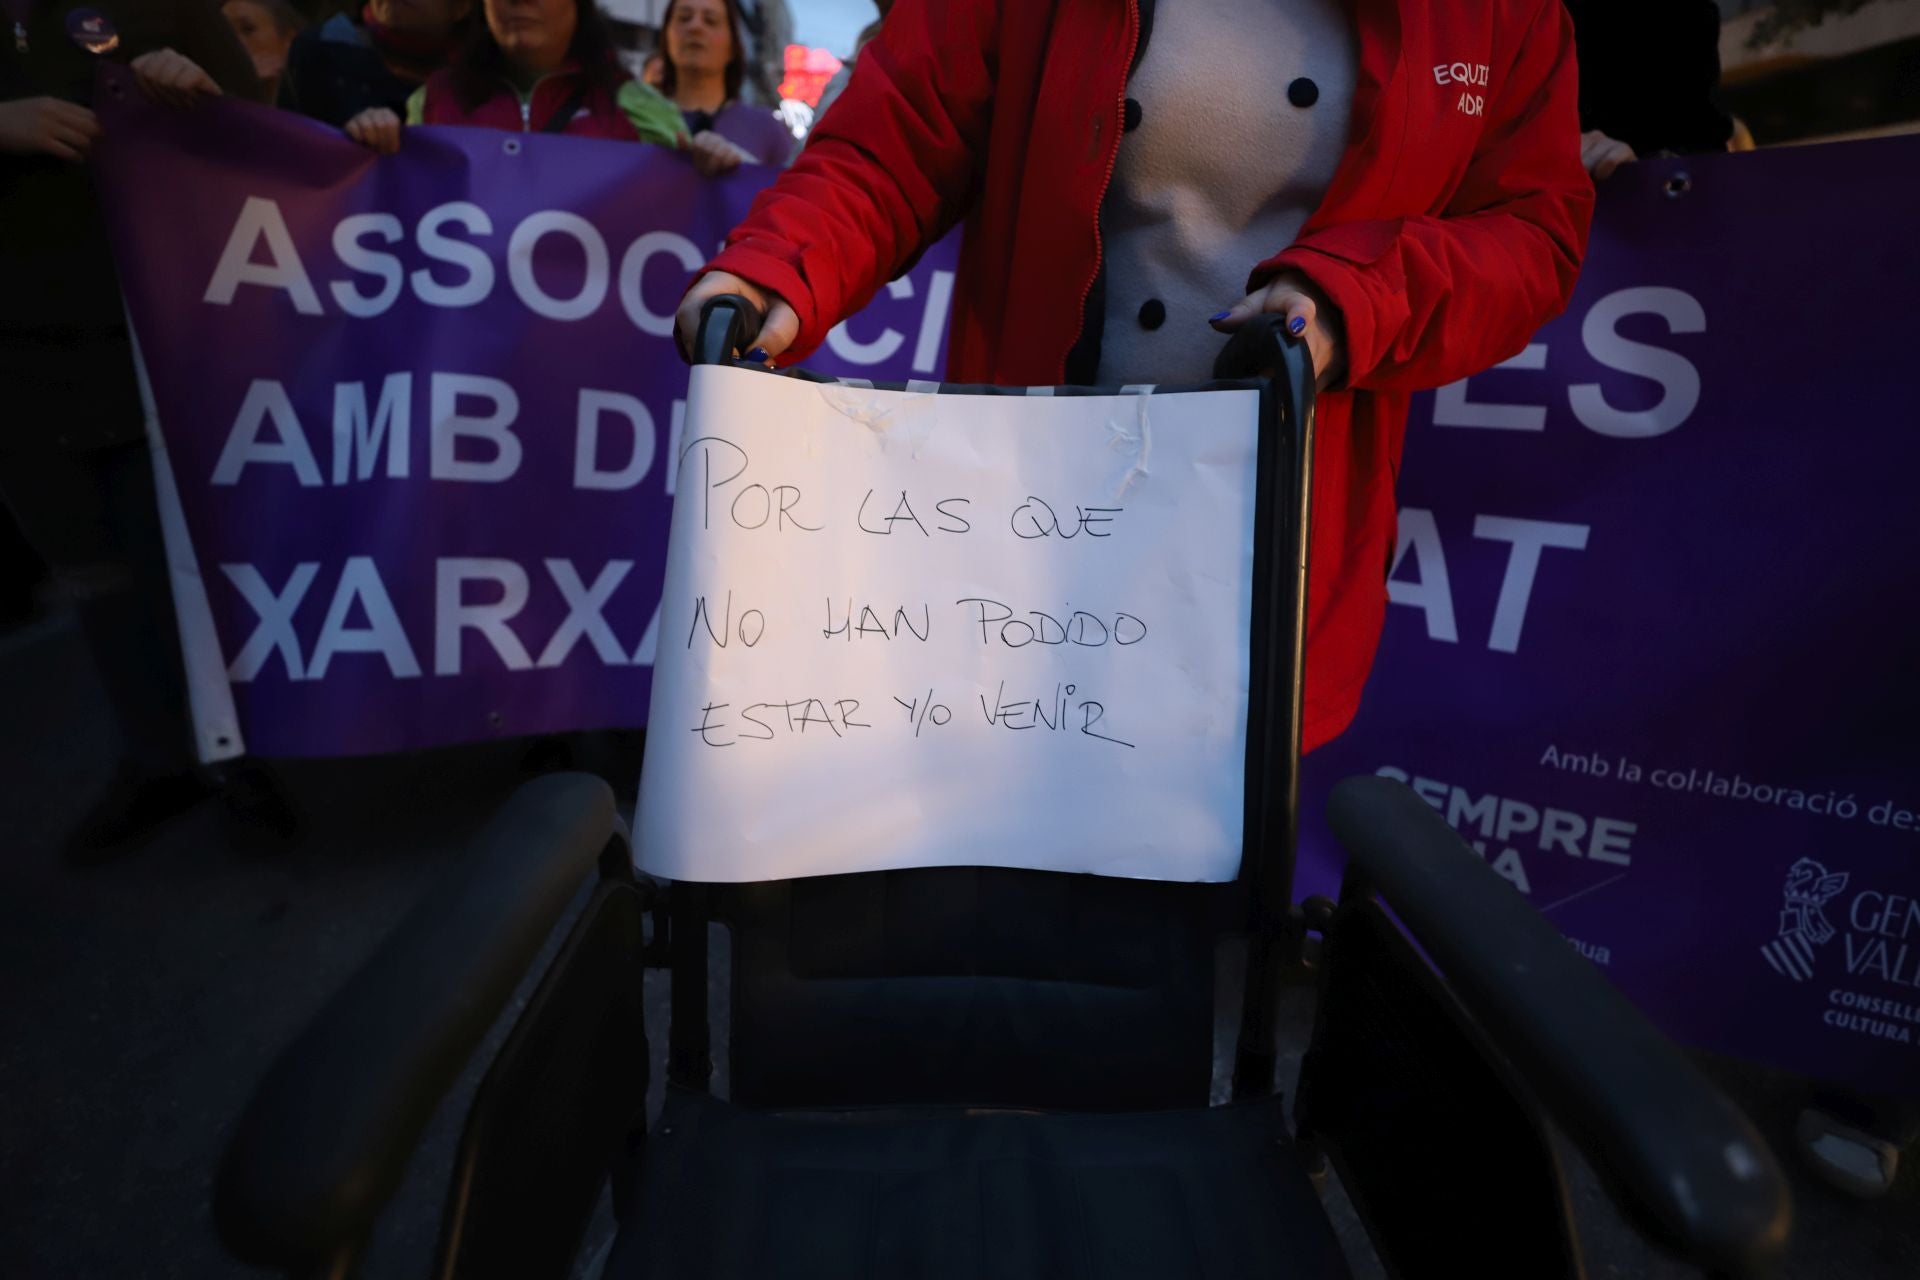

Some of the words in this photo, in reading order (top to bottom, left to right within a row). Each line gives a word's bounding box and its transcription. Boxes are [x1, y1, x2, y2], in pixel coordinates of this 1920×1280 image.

[210, 372, 522, 486] AMB
[679, 437, 825, 531] POR
[858, 489, 970, 536] LAS
[1011, 496, 1123, 539] QUE
[688, 590, 764, 649] NO
[823, 597, 929, 642] HAN
[691, 699, 871, 747] ESTAR
[981, 680, 1135, 747] VENIR
[1540, 744, 1610, 777] Amb
[1617, 757, 1642, 783] la
[1823, 1009, 1910, 1044] CULTURA
